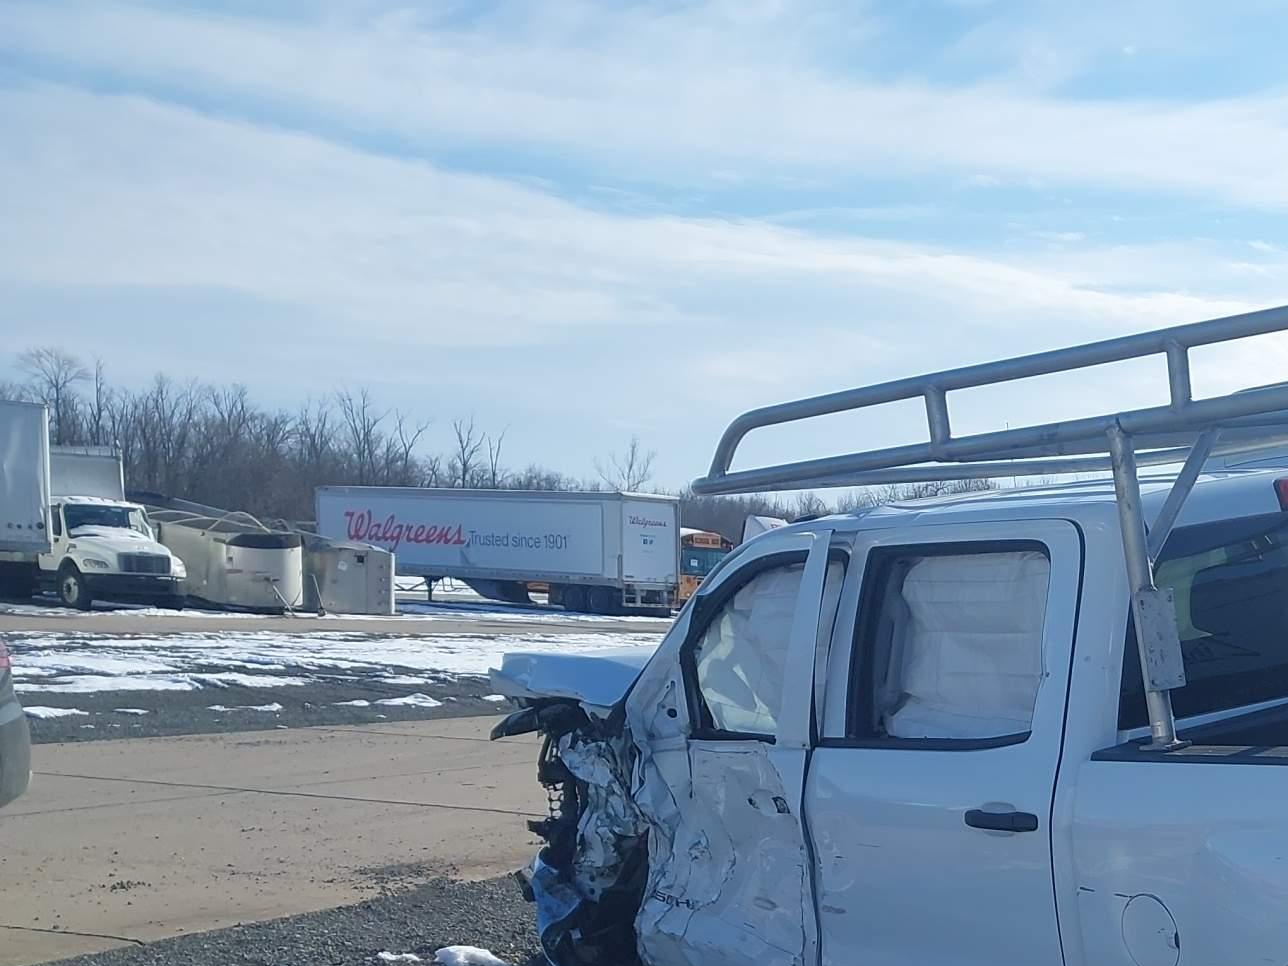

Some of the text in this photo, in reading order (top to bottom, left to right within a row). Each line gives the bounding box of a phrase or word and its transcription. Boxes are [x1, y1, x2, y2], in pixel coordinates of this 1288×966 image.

[343, 509, 568, 552] Walgreens Trusted since 1901
